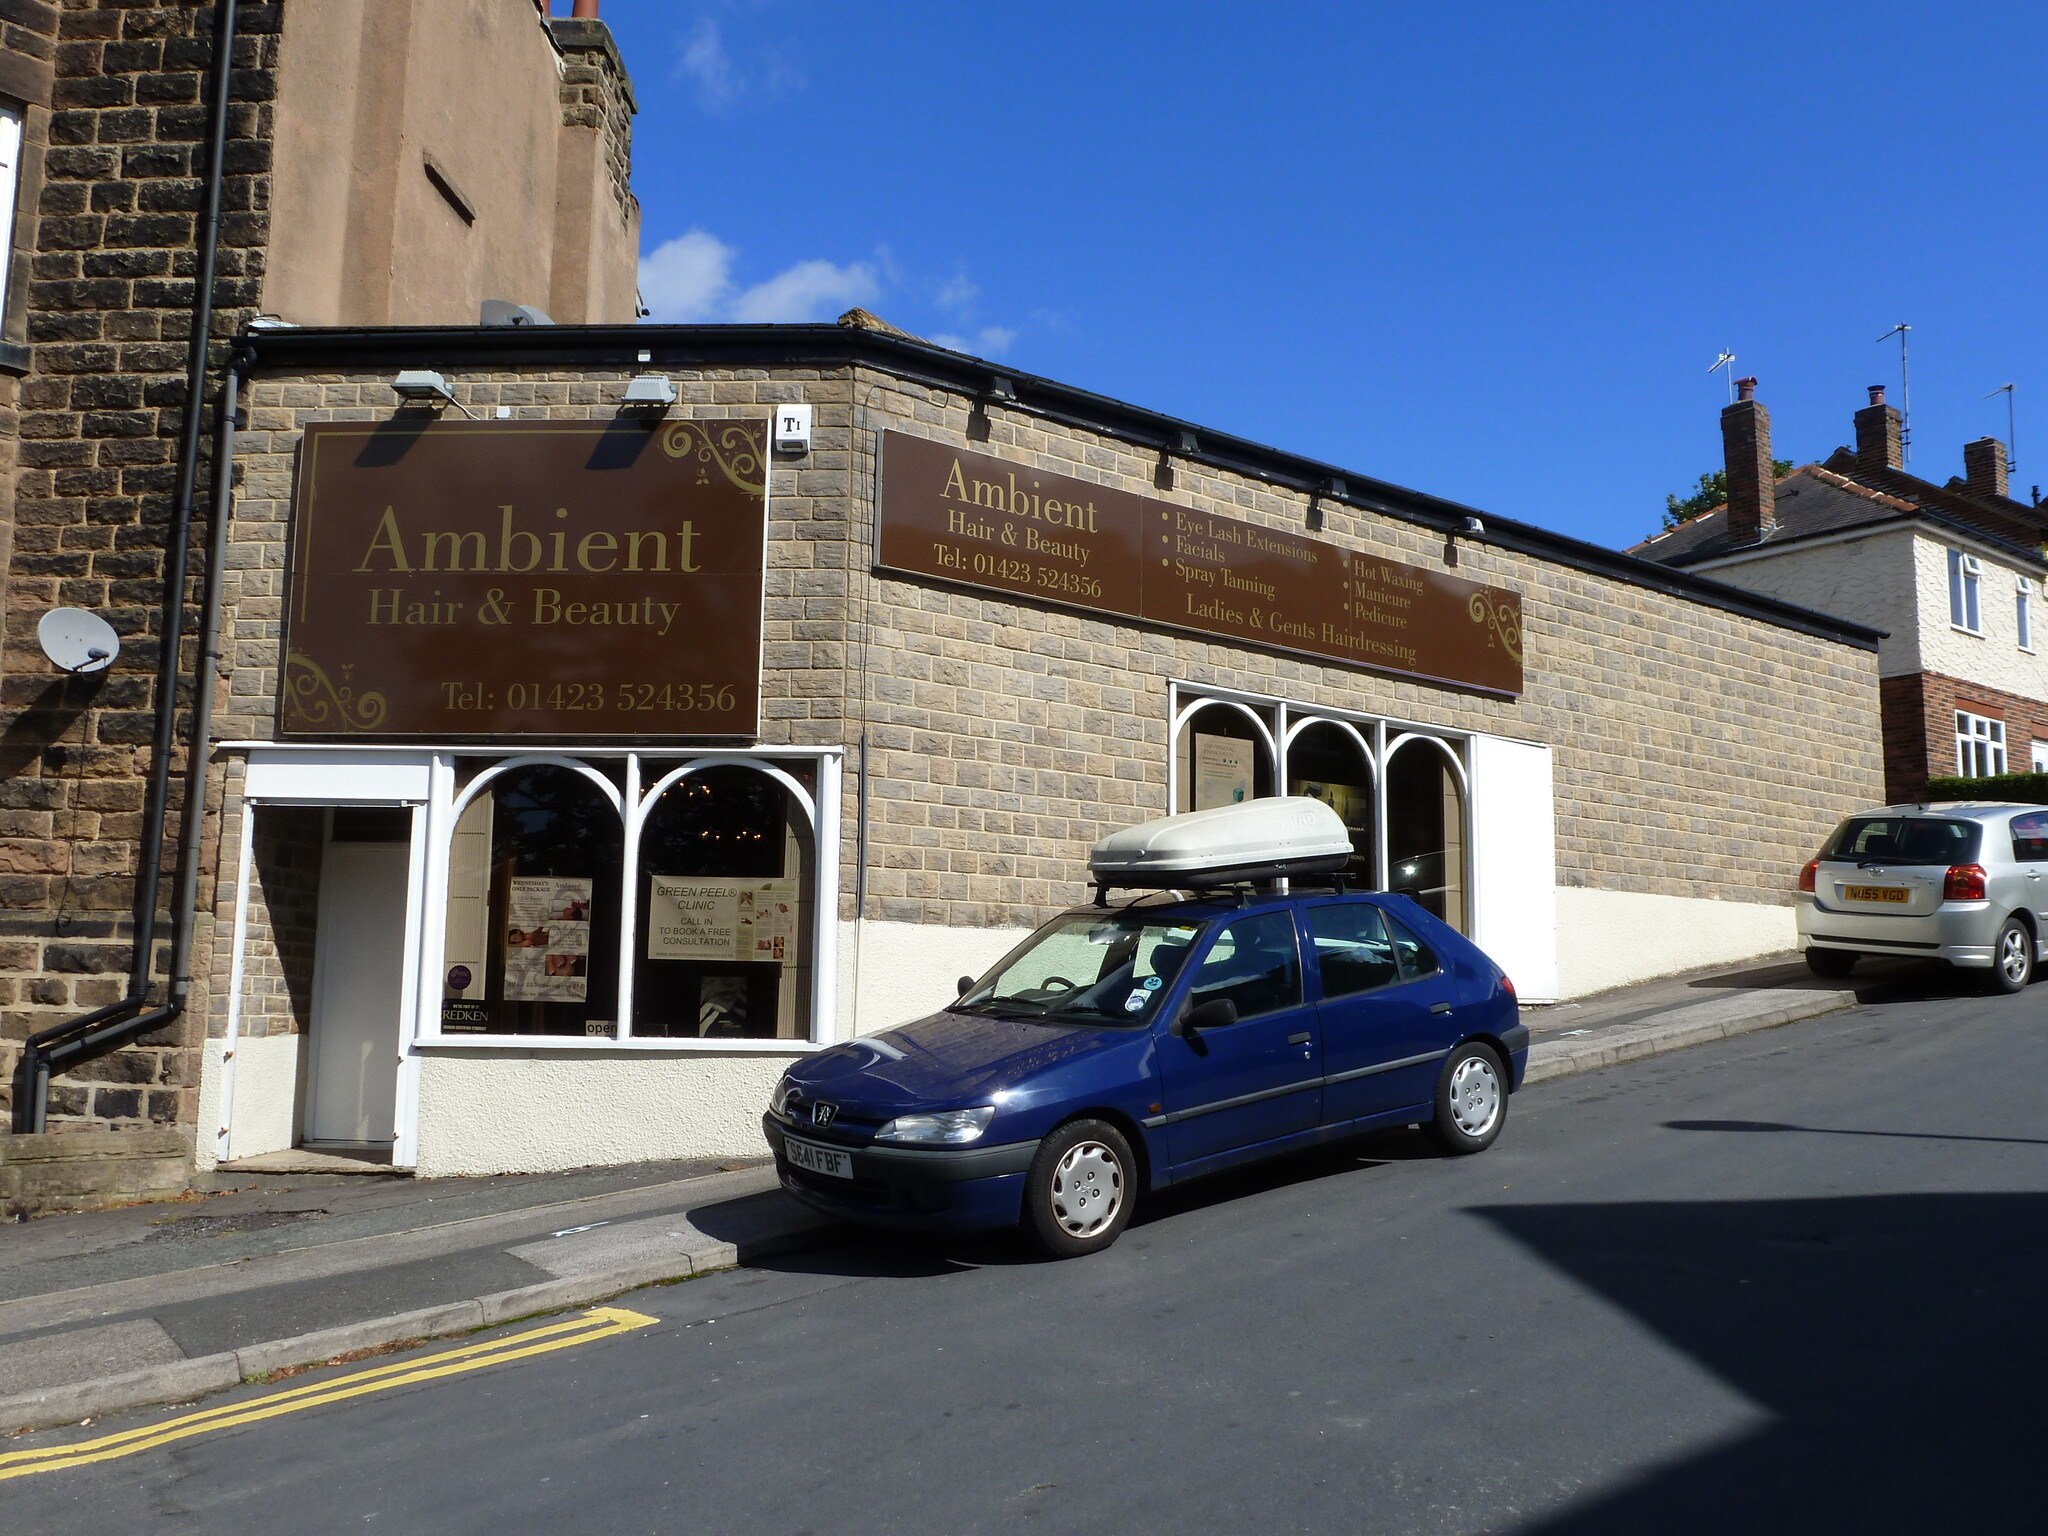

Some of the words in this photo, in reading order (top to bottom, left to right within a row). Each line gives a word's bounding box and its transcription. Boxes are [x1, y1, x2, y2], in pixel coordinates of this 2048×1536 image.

[939, 458, 1098, 534] Ambient
[352, 504, 703, 573] Ambient
[947, 509, 995, 542] Hair
[1000, 522, 1018, 547] &
[1026, 527, 1091, 568] Beauty
[1175, 511, 1203, 537] Eye
[1208, 519, 1242, 545] Lash
[1246, 528, 1319, 564] Extensions
[1175, 534, 1226, 563] Facials
[933, 543, 967, 571] Tel:
[973, 553, 1031, 583] 01423
[1037, 566, 1102, 598] 524356
[1175, 557, 1217, 587] Spray
[1220, 567, 1276, 601] Tanning
[1354, 559, 1377, 580] Hot
[1380, 565, 1424, 597] Waxing
[1354, 580, 1412, 609] Manicure
[367, 588, 464, 626] Hair
[477, 588, 515, 626] &
[531, 588, 682, 636] Beauty
[1354, 601, 1408, 629] Pedicure
[1186, 592, 1244, 625] Ladies
[1249, 607, 1264, 630] &
[1269, 611, 1316, 640] Gents
[1321, 622, 1417, 666] Hairdressing
[441, 681, 496, 712] Tel:
[507, 682, 605, 712] 01423
[616, 682, 736, 712] 524356
[656, 886, 697, 897] GREEN
[677, 900, 716, 910] CLINIC
[1881, 888, 1904, 901] VGD
[659, 926, 671, 934] TO
[673, 927, 698, 935] BOOK
[707, 928, 731, 936] FREE
[680, 917, 702, 925] CALL
[662, 936, 731, 946] CONSULTATION
[442, 1009, 489, 1021] REDKEN
[587, 1024, 617, 1035] open
